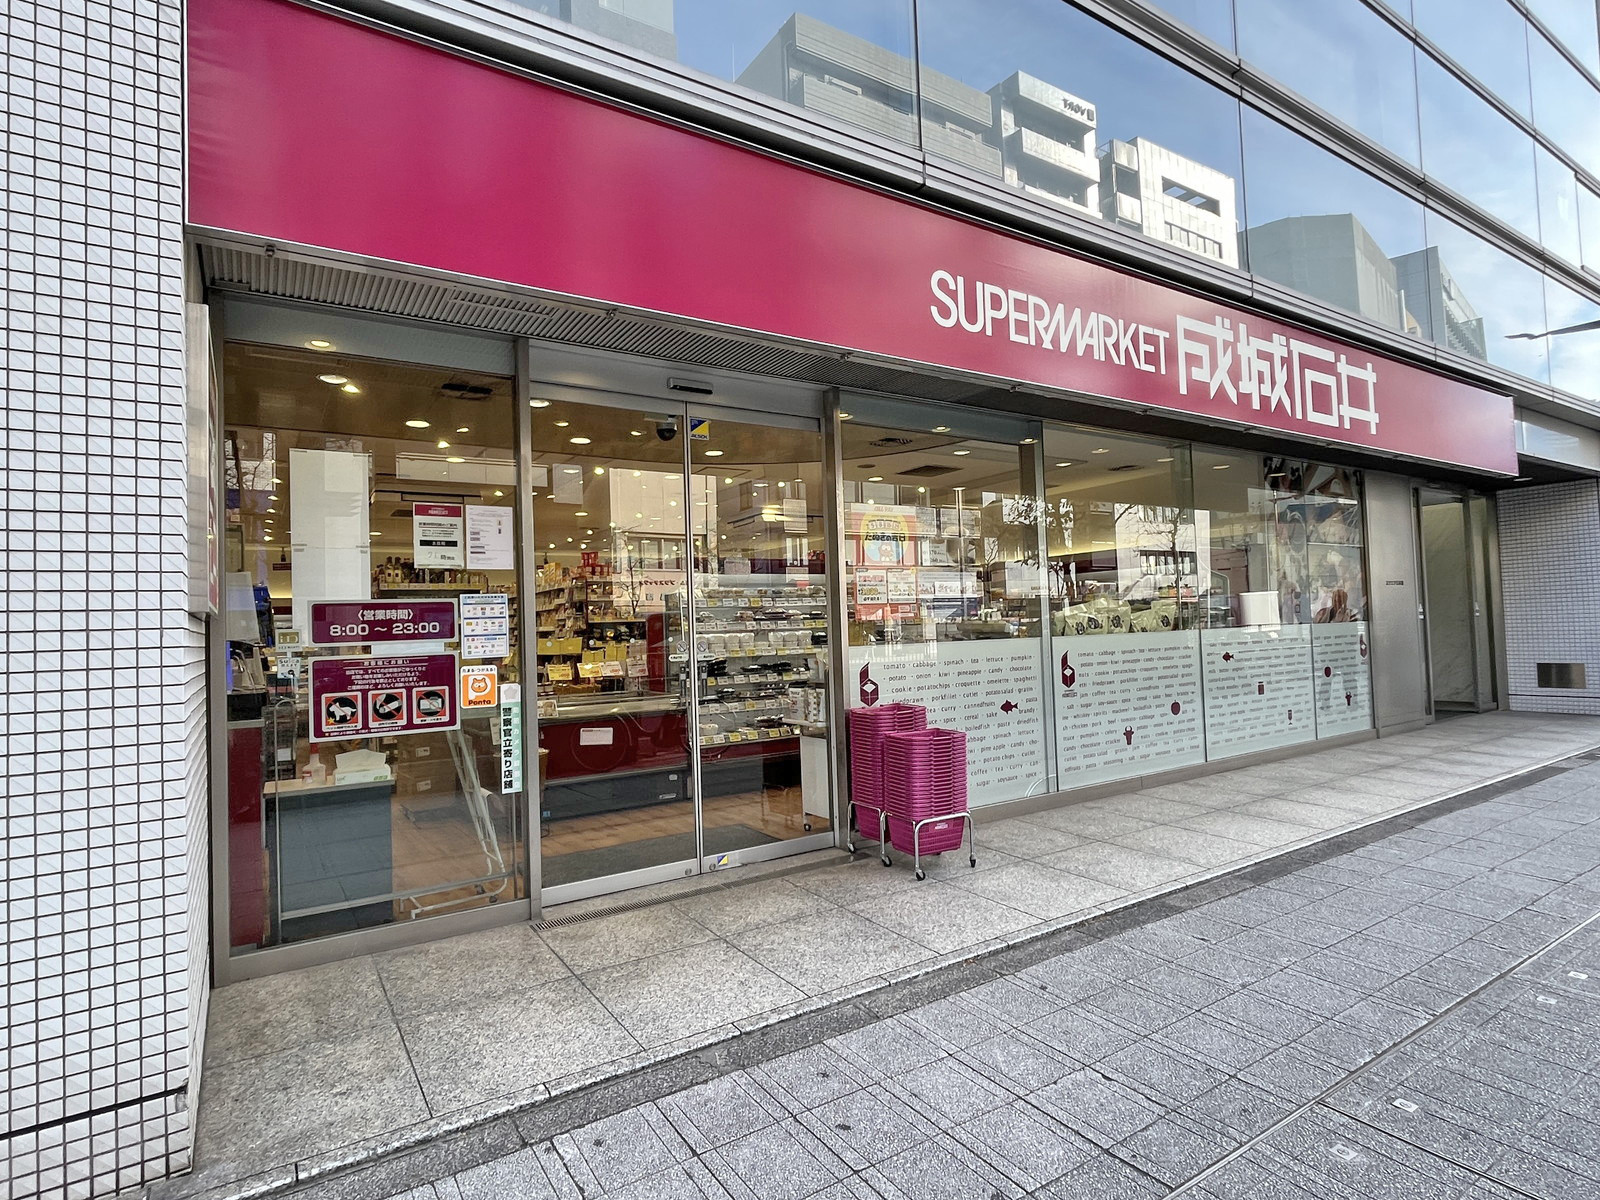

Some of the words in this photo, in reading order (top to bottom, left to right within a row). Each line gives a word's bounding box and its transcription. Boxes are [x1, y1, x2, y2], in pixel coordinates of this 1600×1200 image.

[930, 269, 1170, 375] SUPERMARKET
[1176, 314, 1380, 434] 成城石井
[330, 624, 369, 636] 8:00
[392, 622, 440, 634] 23:00
[503, 707, 513, 790] 警察官立寄り店舗
